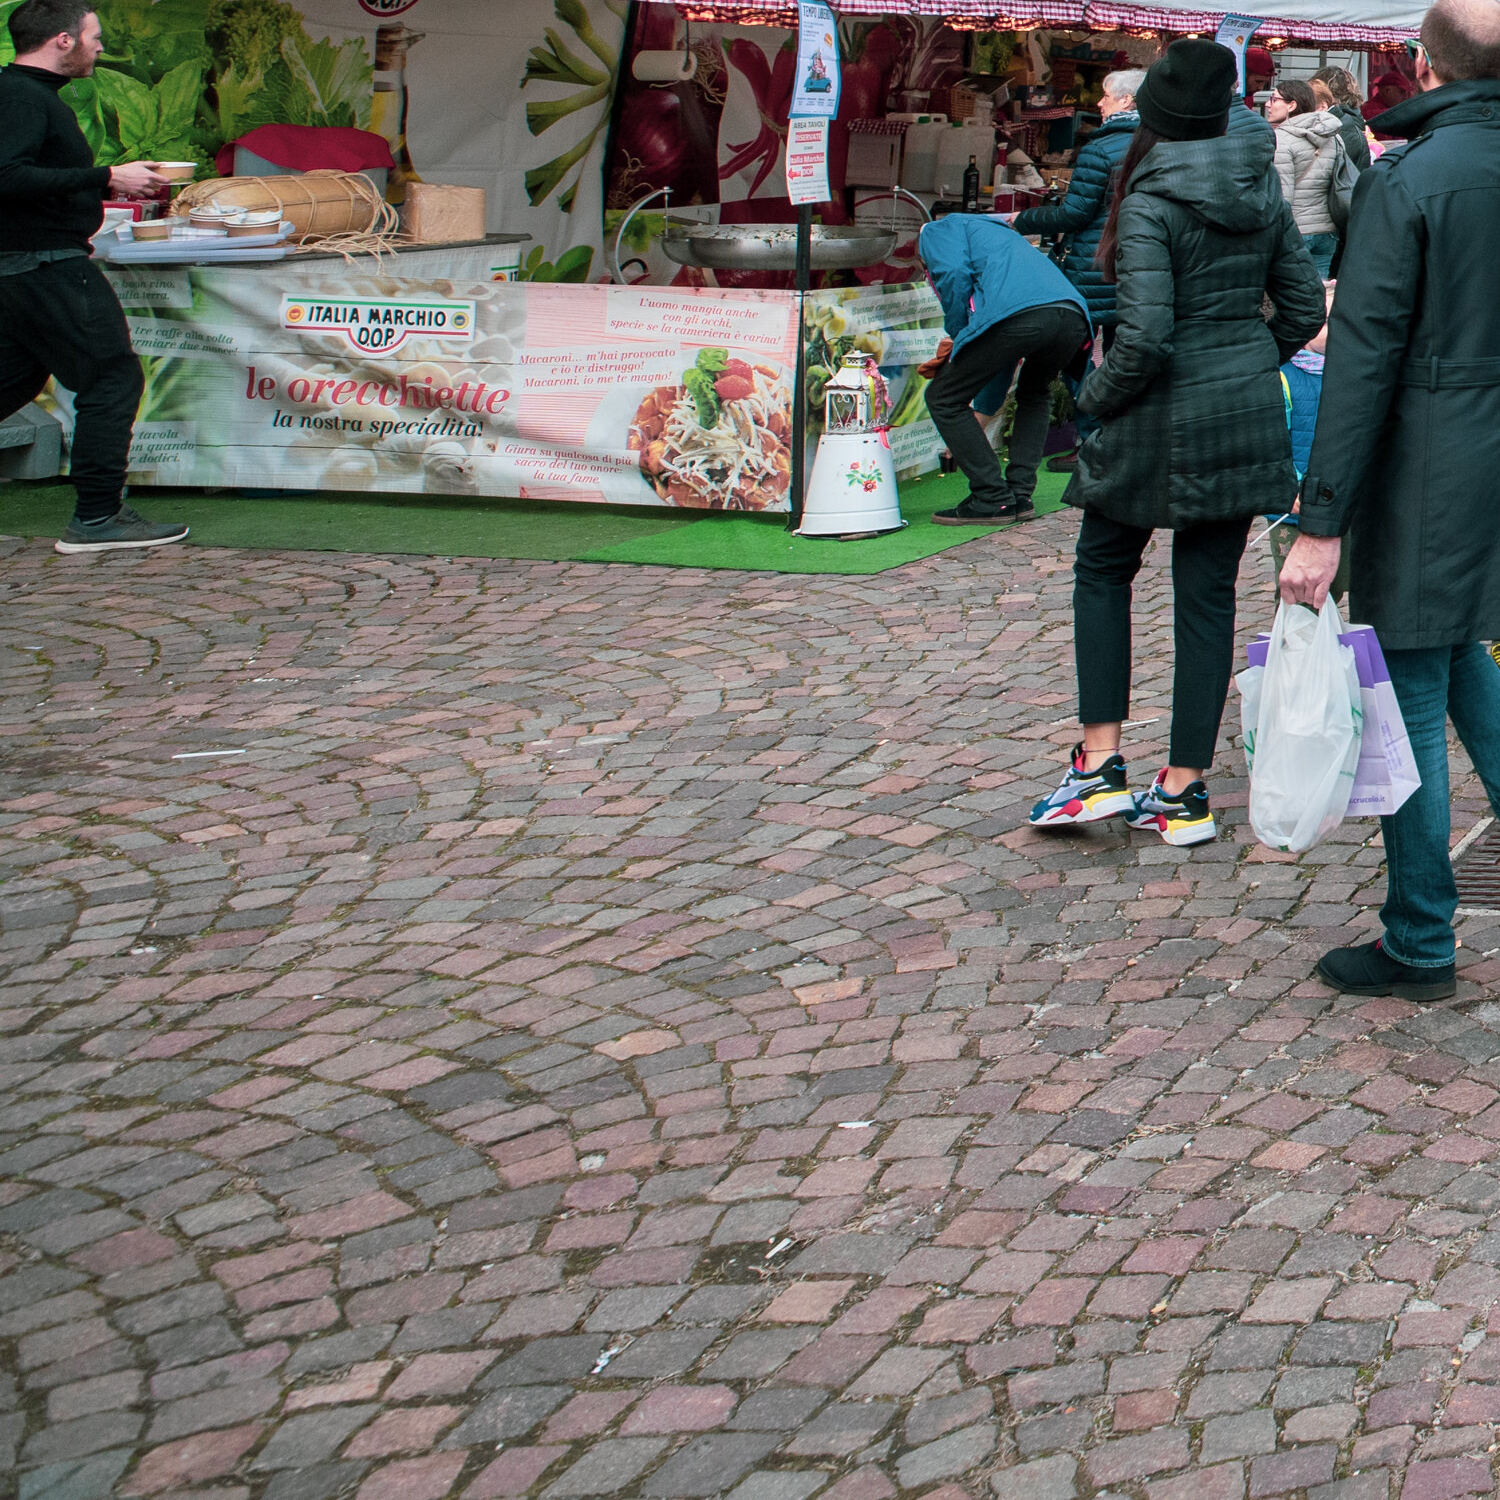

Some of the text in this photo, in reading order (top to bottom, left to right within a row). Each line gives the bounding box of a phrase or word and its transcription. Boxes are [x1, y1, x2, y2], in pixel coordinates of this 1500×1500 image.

[308, 305, 447, 327] ITALIA MARCHIO
[663, 313, 682, 322] con
[685, 313, 699, 326] gli
[681, 304, 723, 315] mangia
[726, 307, 759, 319] anche
[135, 326, 153, 335] tre
[185, 330, 204, 340] alla
[206, 333, 234, 344] volta
[357, 327, 395, 347] D.O.P.
[610, 319, 644, 330] specie
[647, 323, 658, 331] se
[661, 323, 672, 333] la
[674, 326, 731, 340] cameriera
[744, 333, 781, 345] carina!
[179, 341, 200, 350] due
[519, 349, 676, 365] Macaroni... m'hai provocato
[551, 361, 645, 375] e io te distruggo!
[523, 371, 672, 388] Macaroni, io me te magno!
[246, 366, 511, 415] le orecchiette
[272, 410, 484, 438] la nostra specialità!
[138, 429, 179, 439] tavola
[147, 441, 195, 453] quando
[504, 443, 632, 466] Giura su qualcosa di più
[140, 453, 180, 463] dodici.
[514, 458, 622, 474] sacro del tuo onore:
[533, 469, 545, 480] la
[548, 471, 567, 481] tua
